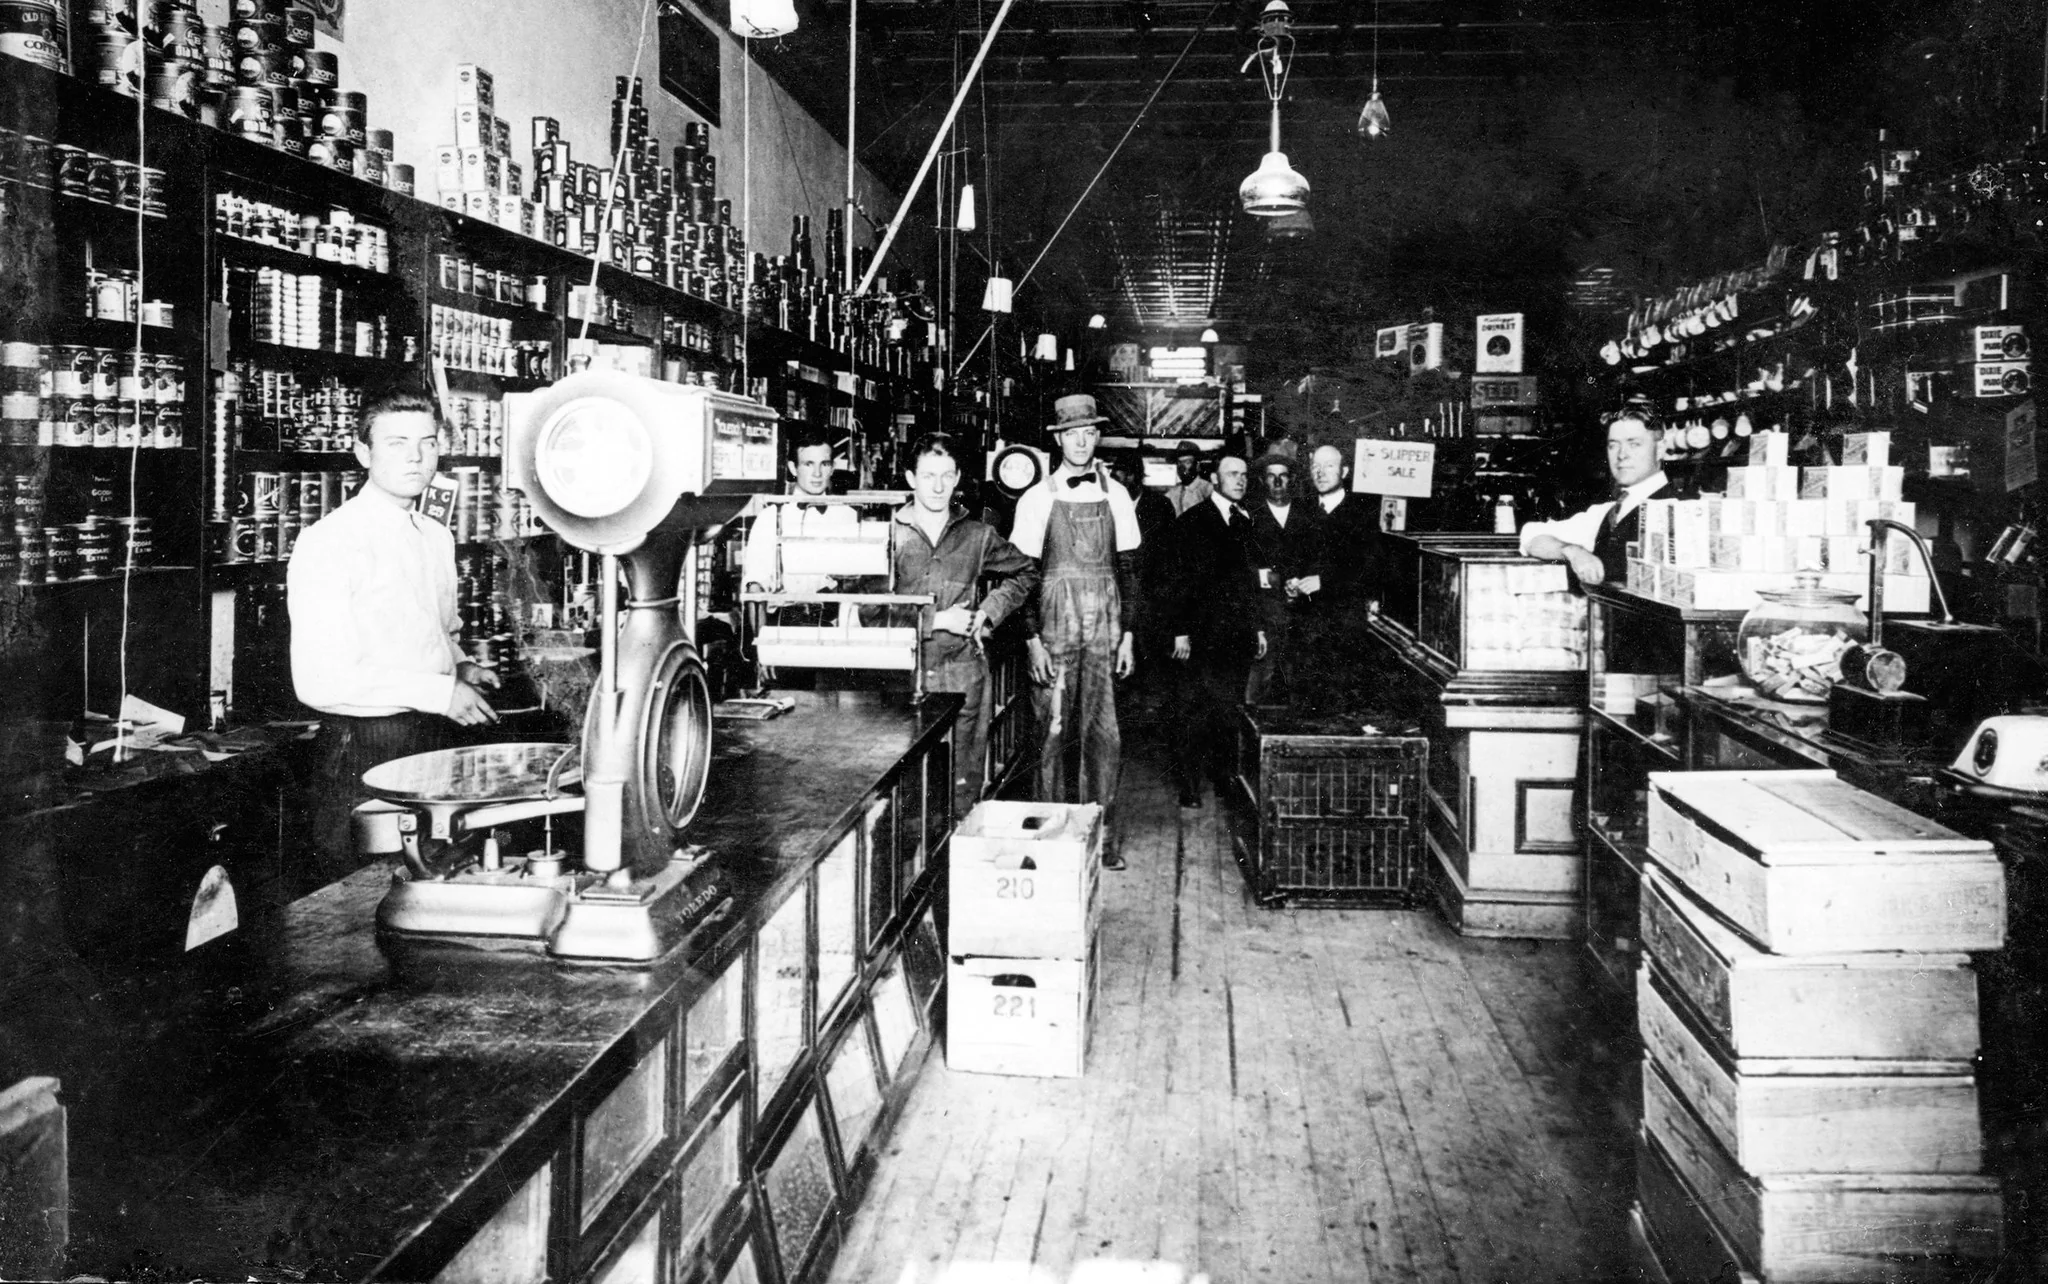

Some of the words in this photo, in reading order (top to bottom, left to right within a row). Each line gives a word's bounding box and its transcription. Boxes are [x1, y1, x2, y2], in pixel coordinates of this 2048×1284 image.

[22, 11, 39, 22] OLD
[1381, 448, 1431, 462] SLIPPER
[1388, 466, 1416, 479] SALE
[996, 876, 1035, 900] 210
[994, 994, 1036, 1019] 221
